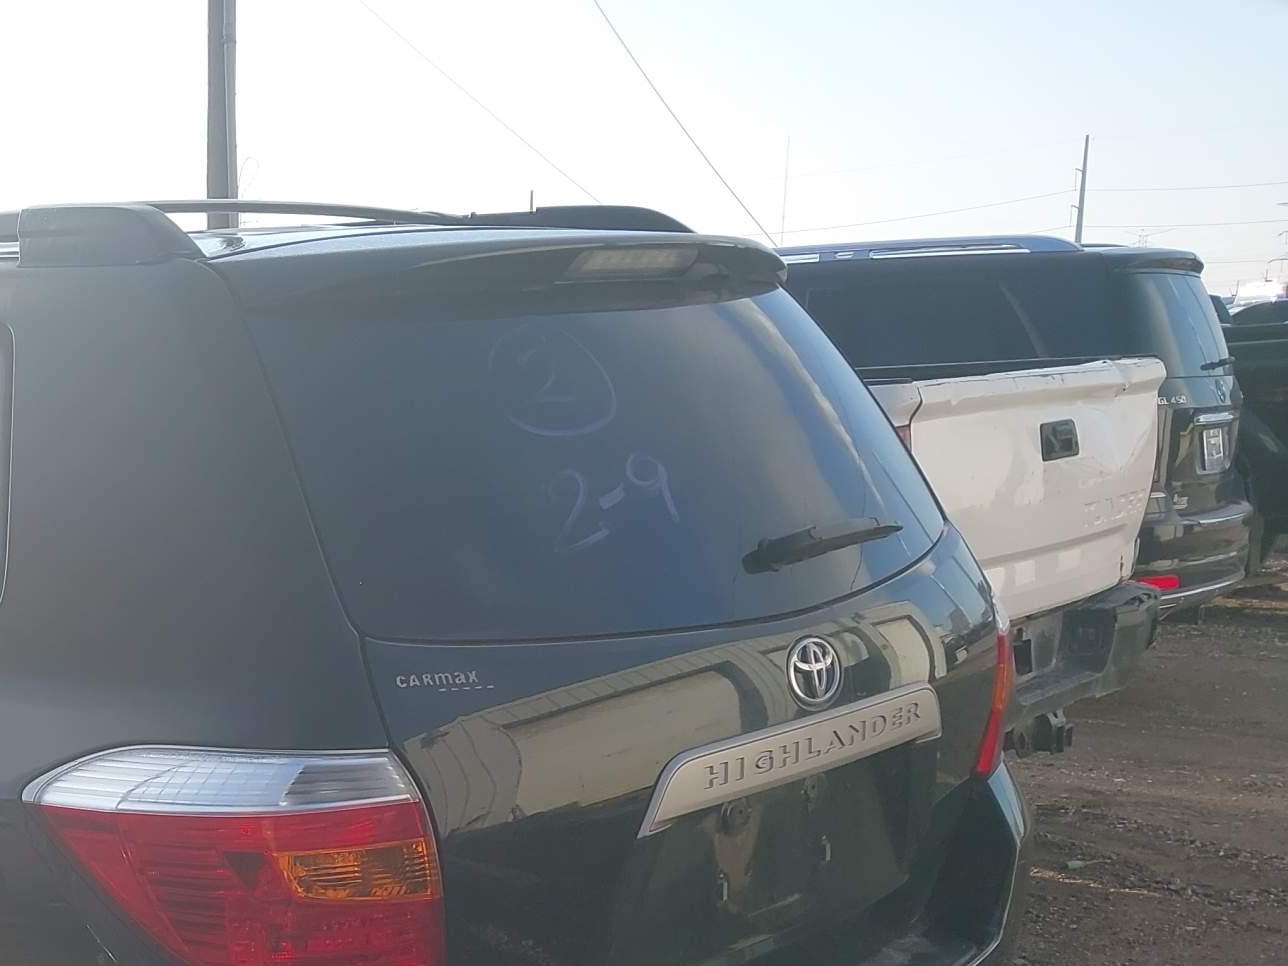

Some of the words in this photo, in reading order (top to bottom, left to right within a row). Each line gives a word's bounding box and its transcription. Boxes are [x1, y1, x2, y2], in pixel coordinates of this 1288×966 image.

[1158, 396, 1169, 405] GL
[546, 450, 680, 552] 2-9
[703, 701, 921, 790] HIGHLANDER
